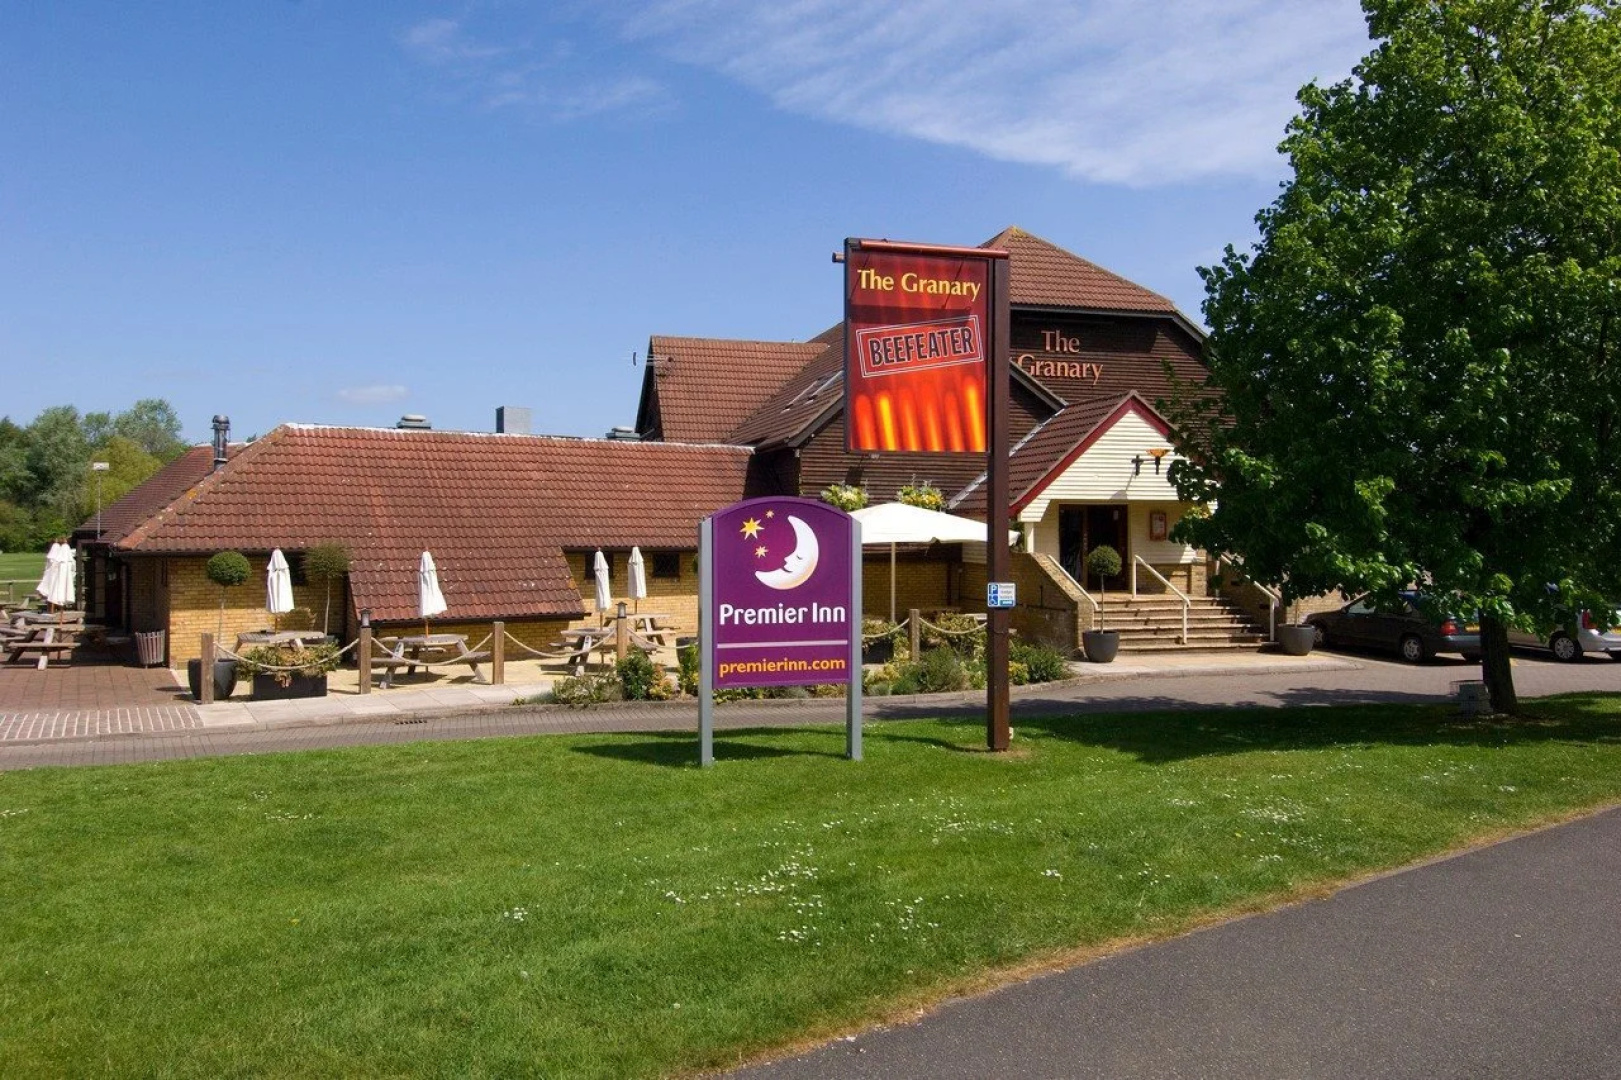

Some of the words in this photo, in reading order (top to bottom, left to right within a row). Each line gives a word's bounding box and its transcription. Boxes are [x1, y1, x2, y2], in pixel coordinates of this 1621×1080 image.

[857, 269, 894, 290] The
[901, 272, 981, 302] Granary
[869, 327, 975, 366] BEEFEATER
[1041, 330, 1080, 353] The
[1017, 354, 1104, 385] Granary
[719, 603, 808, 625] Premier
[812, 602, 846, 623] Inn
[719, 658, 846, 677] premierinn.com
